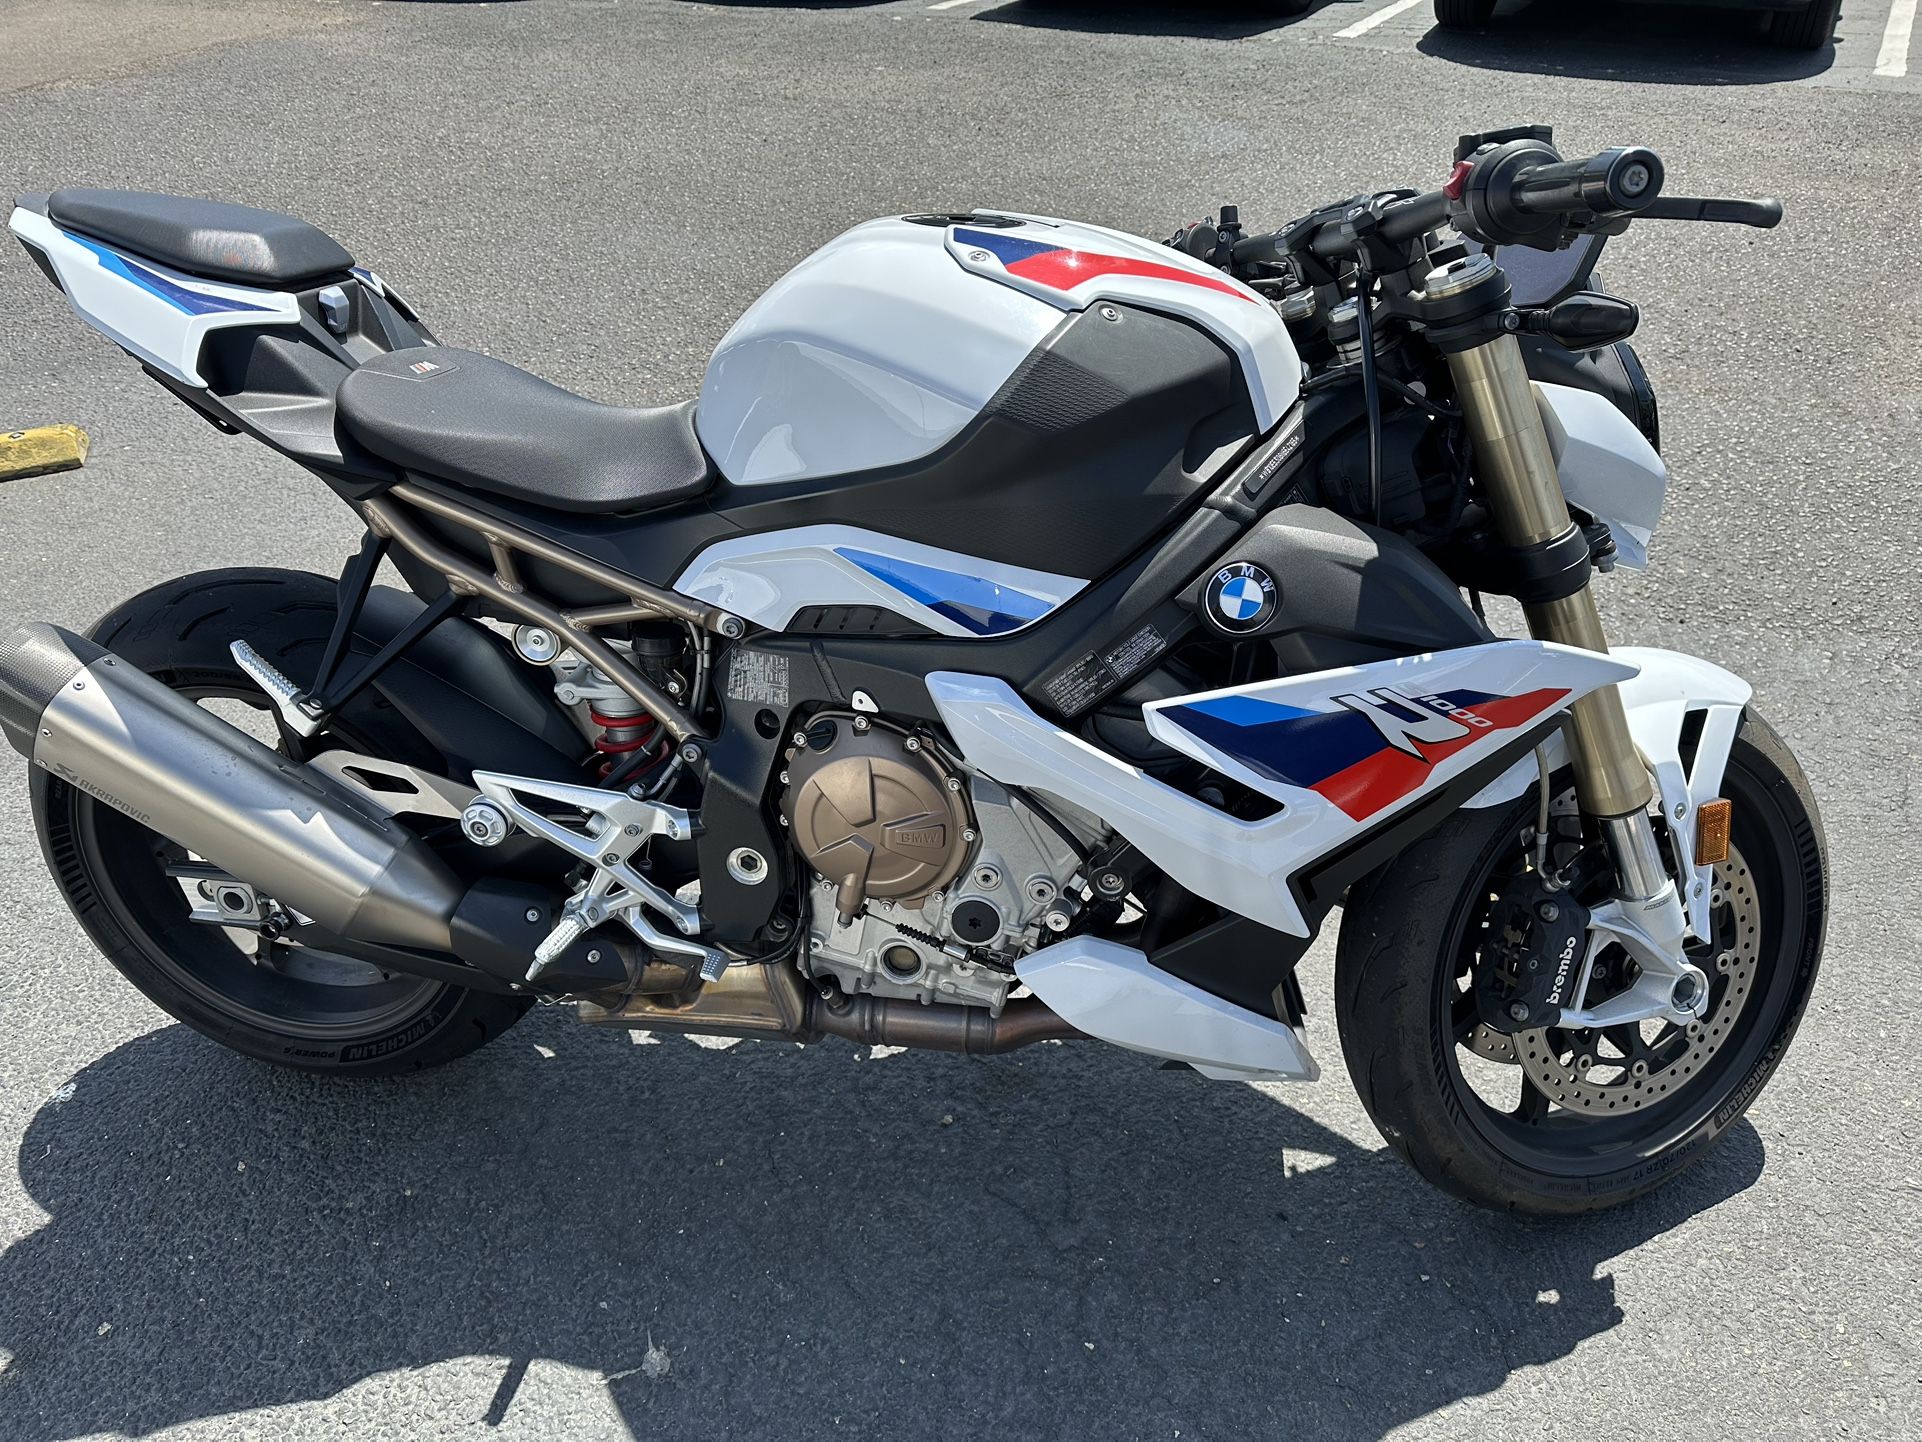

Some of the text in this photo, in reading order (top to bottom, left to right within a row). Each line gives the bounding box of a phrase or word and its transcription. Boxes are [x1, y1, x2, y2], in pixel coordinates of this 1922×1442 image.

[1217, 565, 1275, 592] BMW
[1420, 694, 1494, 727] 1000
[901, 832, 938, 843] BMW
[1546, 936, 1576, 1004] brembo
[294, 1048, 336, 1058] POWER
[350, 1019, 426, 1060] MICHELIN
[1718, 1058, 1770, 1123] MICHELIN
